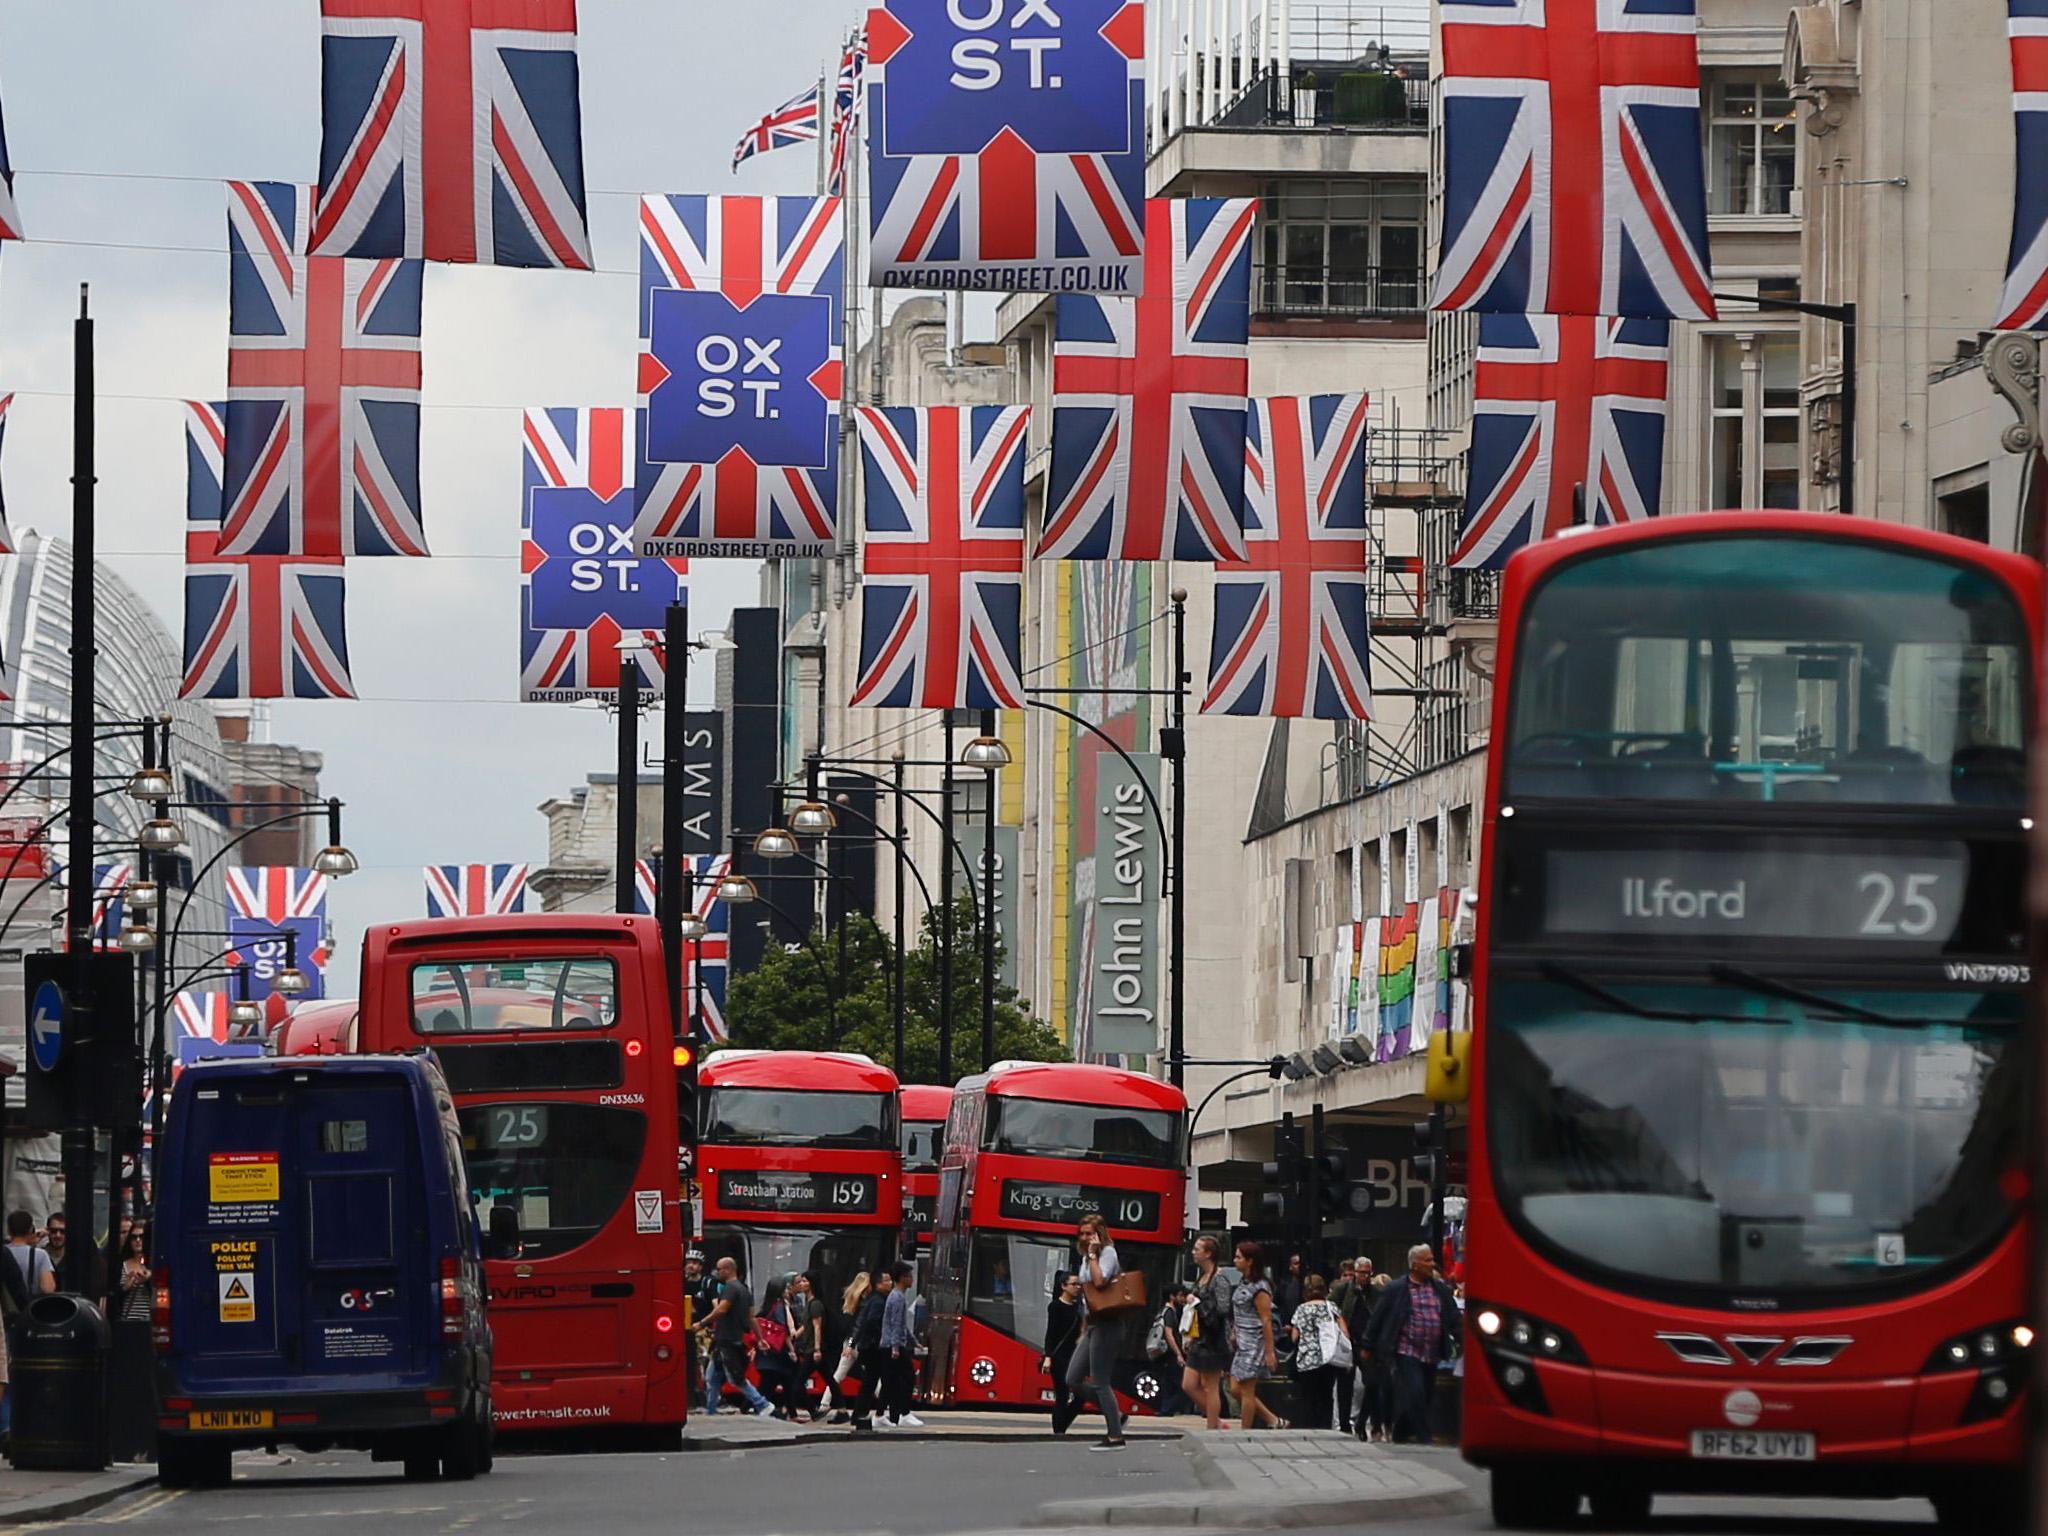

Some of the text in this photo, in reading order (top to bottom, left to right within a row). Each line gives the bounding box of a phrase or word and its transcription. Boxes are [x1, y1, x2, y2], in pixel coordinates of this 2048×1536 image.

[946, 0, 1061, 31] OX
[950, 38, 1062, 90] ST.
[883, 265, 1128, 291] OXFORDSTREET.CO.UK
[696, 335, 781, 375] OX
[697, 378, 780, 418] ST.
[569, 523, 634, 556] OX
[643, 541, 824, 558] OXFORDSTREET.CO.UK
[570, 559, 639, 591] ST.
[1097, 783, 1154, 1023] John Lewis
[1622, 872, 1938, 935] Ilford 25
[600, 1094, 645, 1105] DN33636
[497, 1109, 538, 1142] 25
[728, 1180, 864, 1205] Streatham Station 159
[1010, 1189, 1143, 1223] King's Cross 10
[211, 1242, 257, 1254] POLICE
[217, 1255, 252, 1263] FOLLOW
[216, 1262, 255, 1271] THIS VAN
